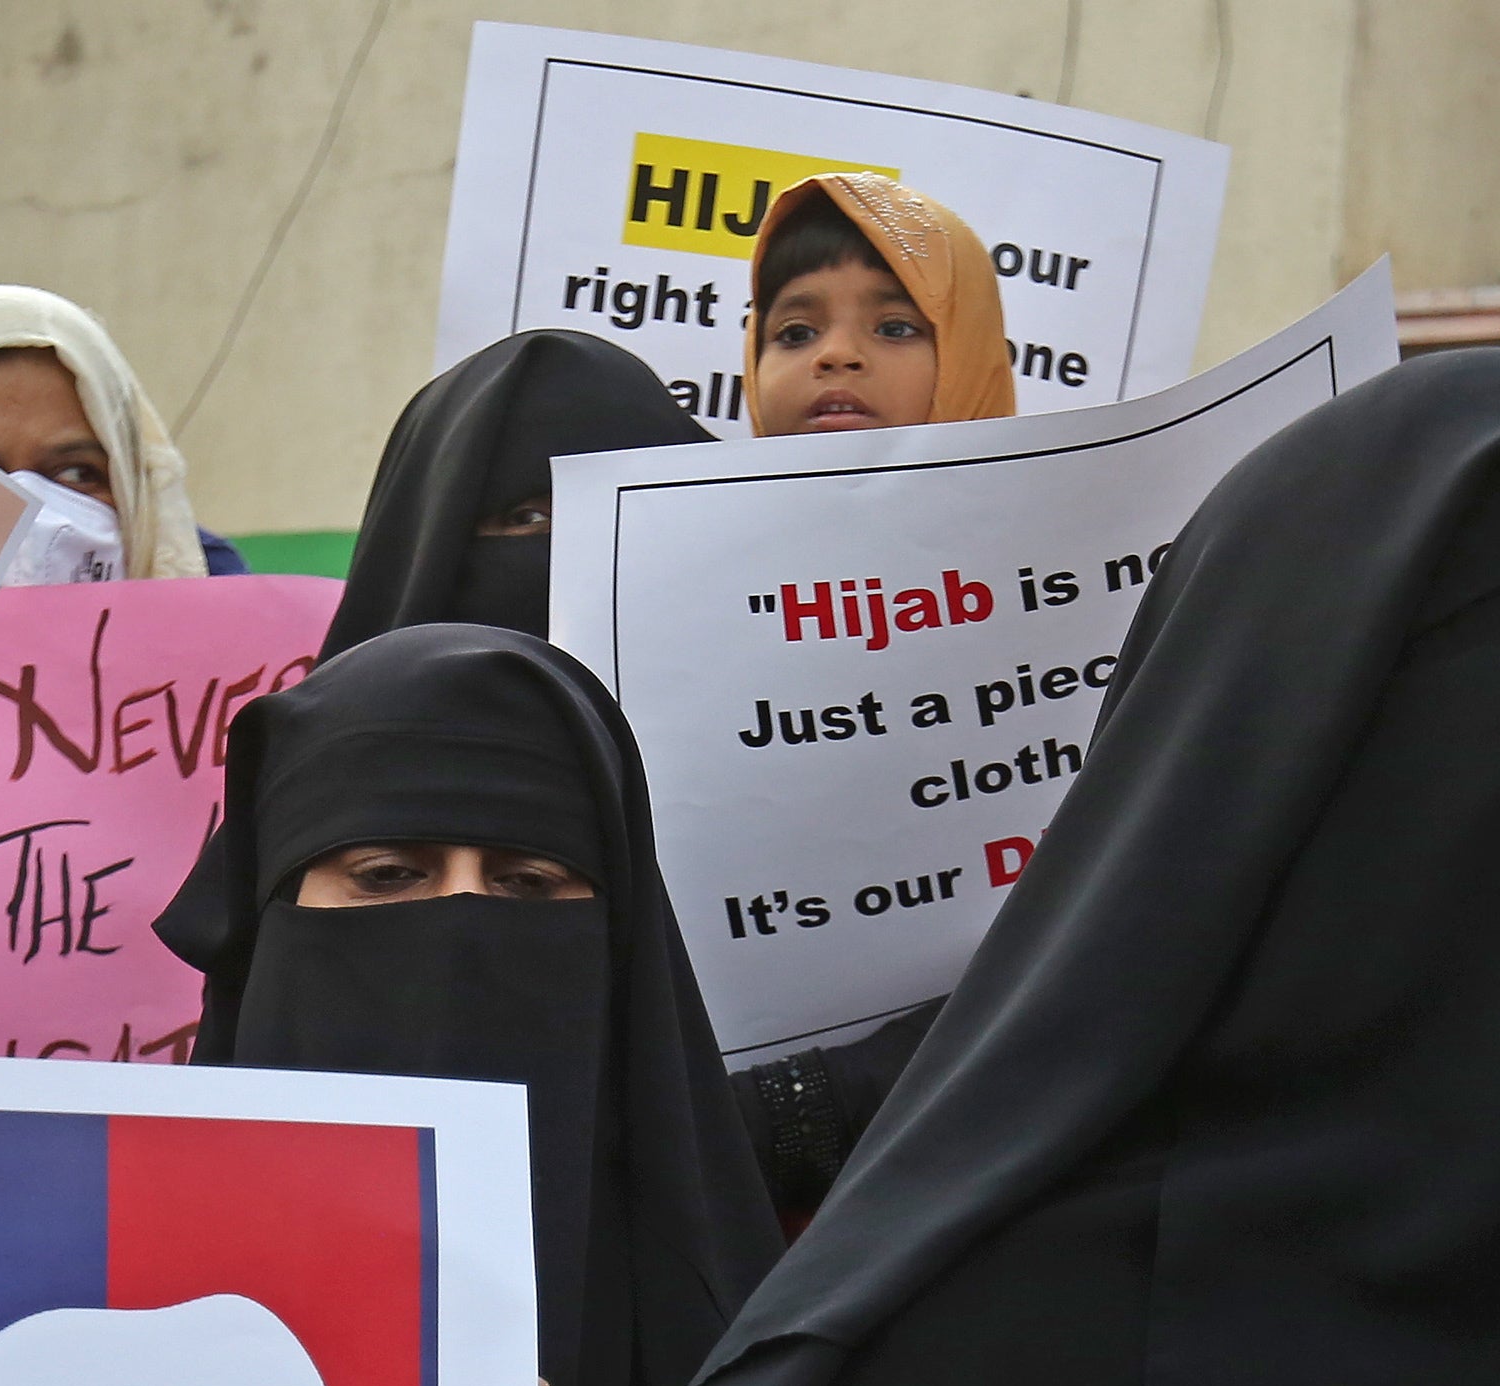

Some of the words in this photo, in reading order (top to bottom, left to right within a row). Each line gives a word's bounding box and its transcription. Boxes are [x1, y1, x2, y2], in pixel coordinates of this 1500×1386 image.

[631, 164, 771, 237] HIJ
[992, 244, 1089, 290] our
[563, 267, 719, 329] right
[668, 373, 744, 420] all
[1017, 566, 1080, 612] is
[738, 690, 887, 748] Just
[910, 692, 952, 728] a
[975, 654, 1117, 727] piec
[910, 738, 1082, 809] cloth
[853, 864, 962, 917] our
